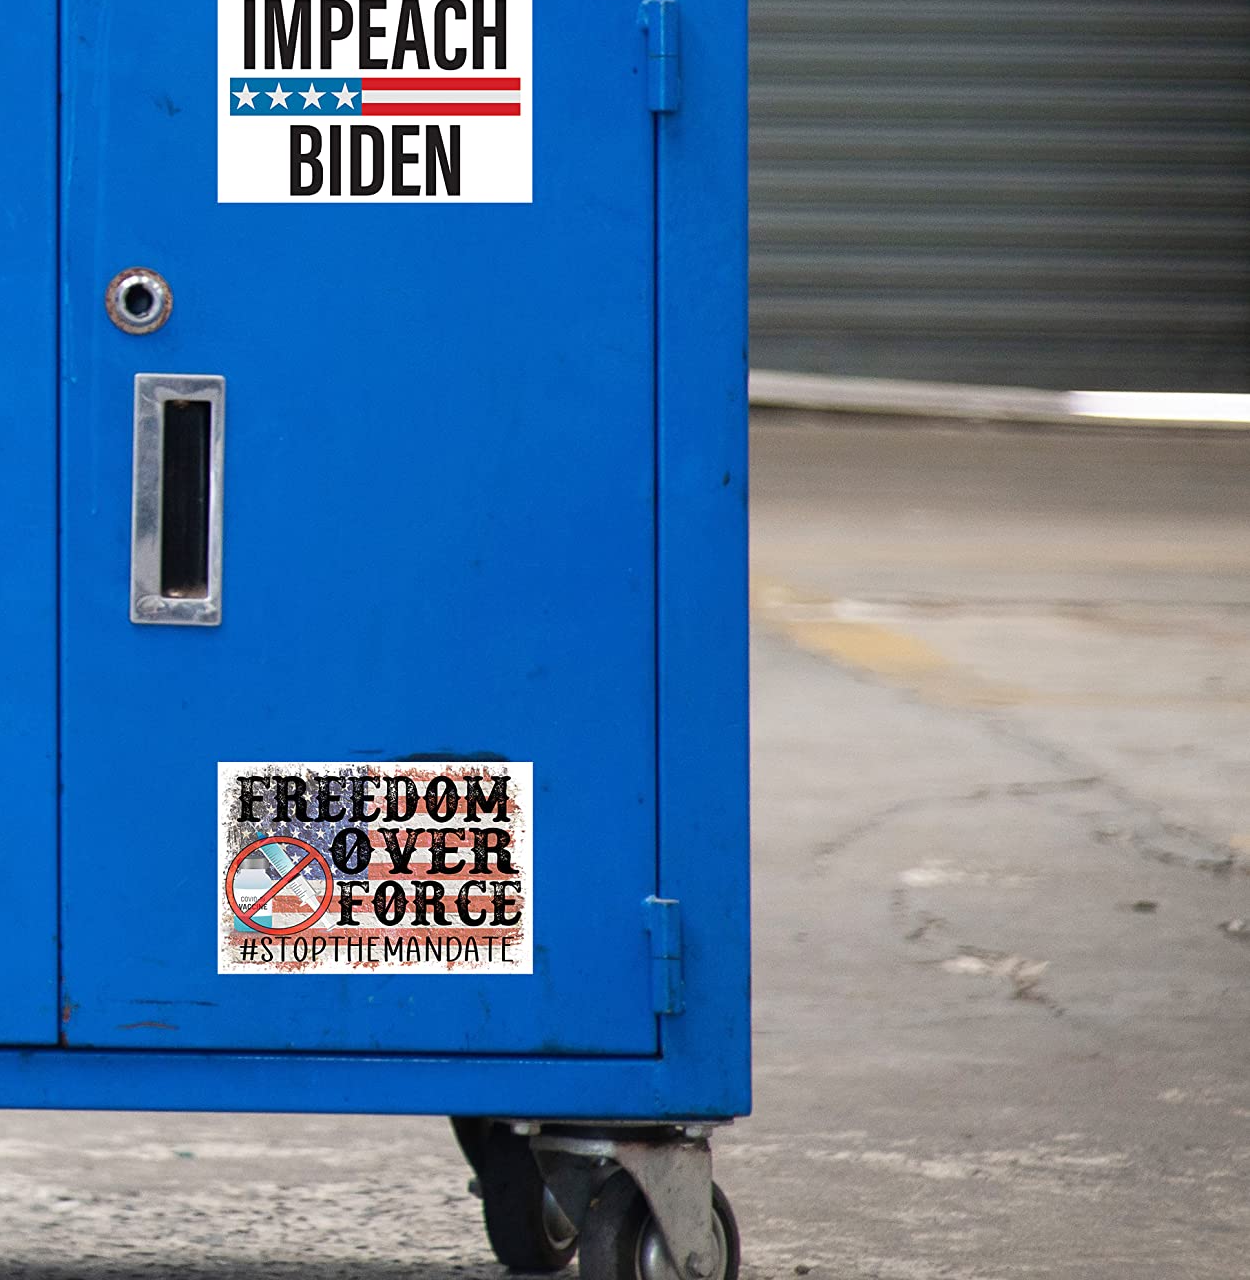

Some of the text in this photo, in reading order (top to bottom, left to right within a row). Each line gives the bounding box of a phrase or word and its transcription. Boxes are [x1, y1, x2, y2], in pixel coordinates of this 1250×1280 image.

[290, 125, 461, 196] BIDEN
[237, 775, 512, 823] FREEDOM
[329, 827, 520, 875] OVER
[336, 880, 522, 927] FORCE
[240, 936, 514, 963] #STOPTHEMANDATE
